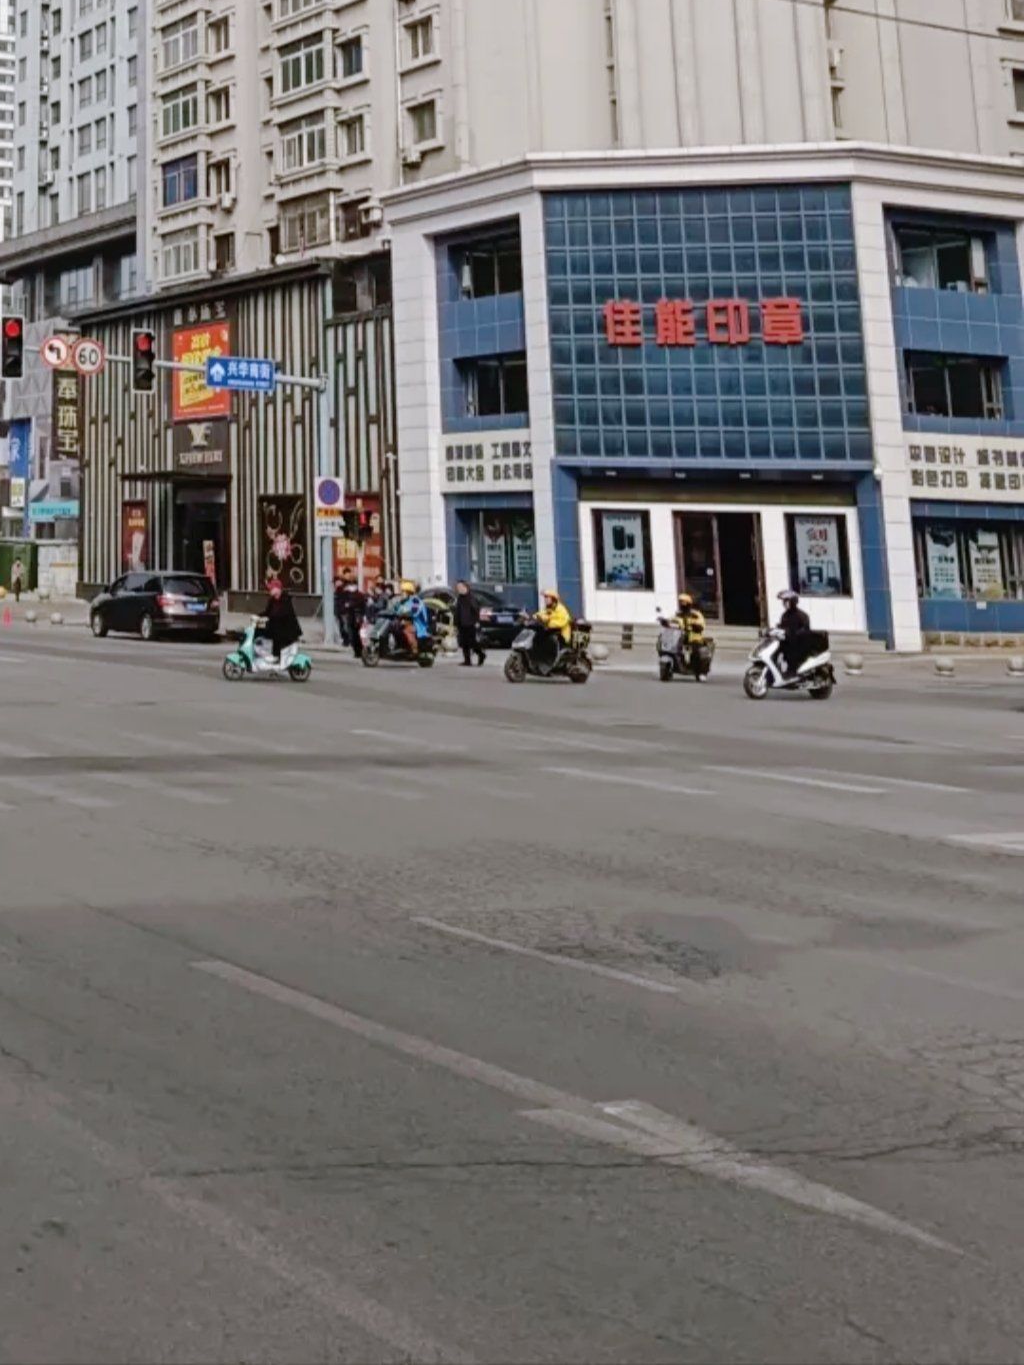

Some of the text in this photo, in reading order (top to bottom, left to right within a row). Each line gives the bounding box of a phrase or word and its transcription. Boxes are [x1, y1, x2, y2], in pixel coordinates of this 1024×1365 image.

[603, 298, 804, 346] 佳能印章
[79, 348, 98, 366] 60
